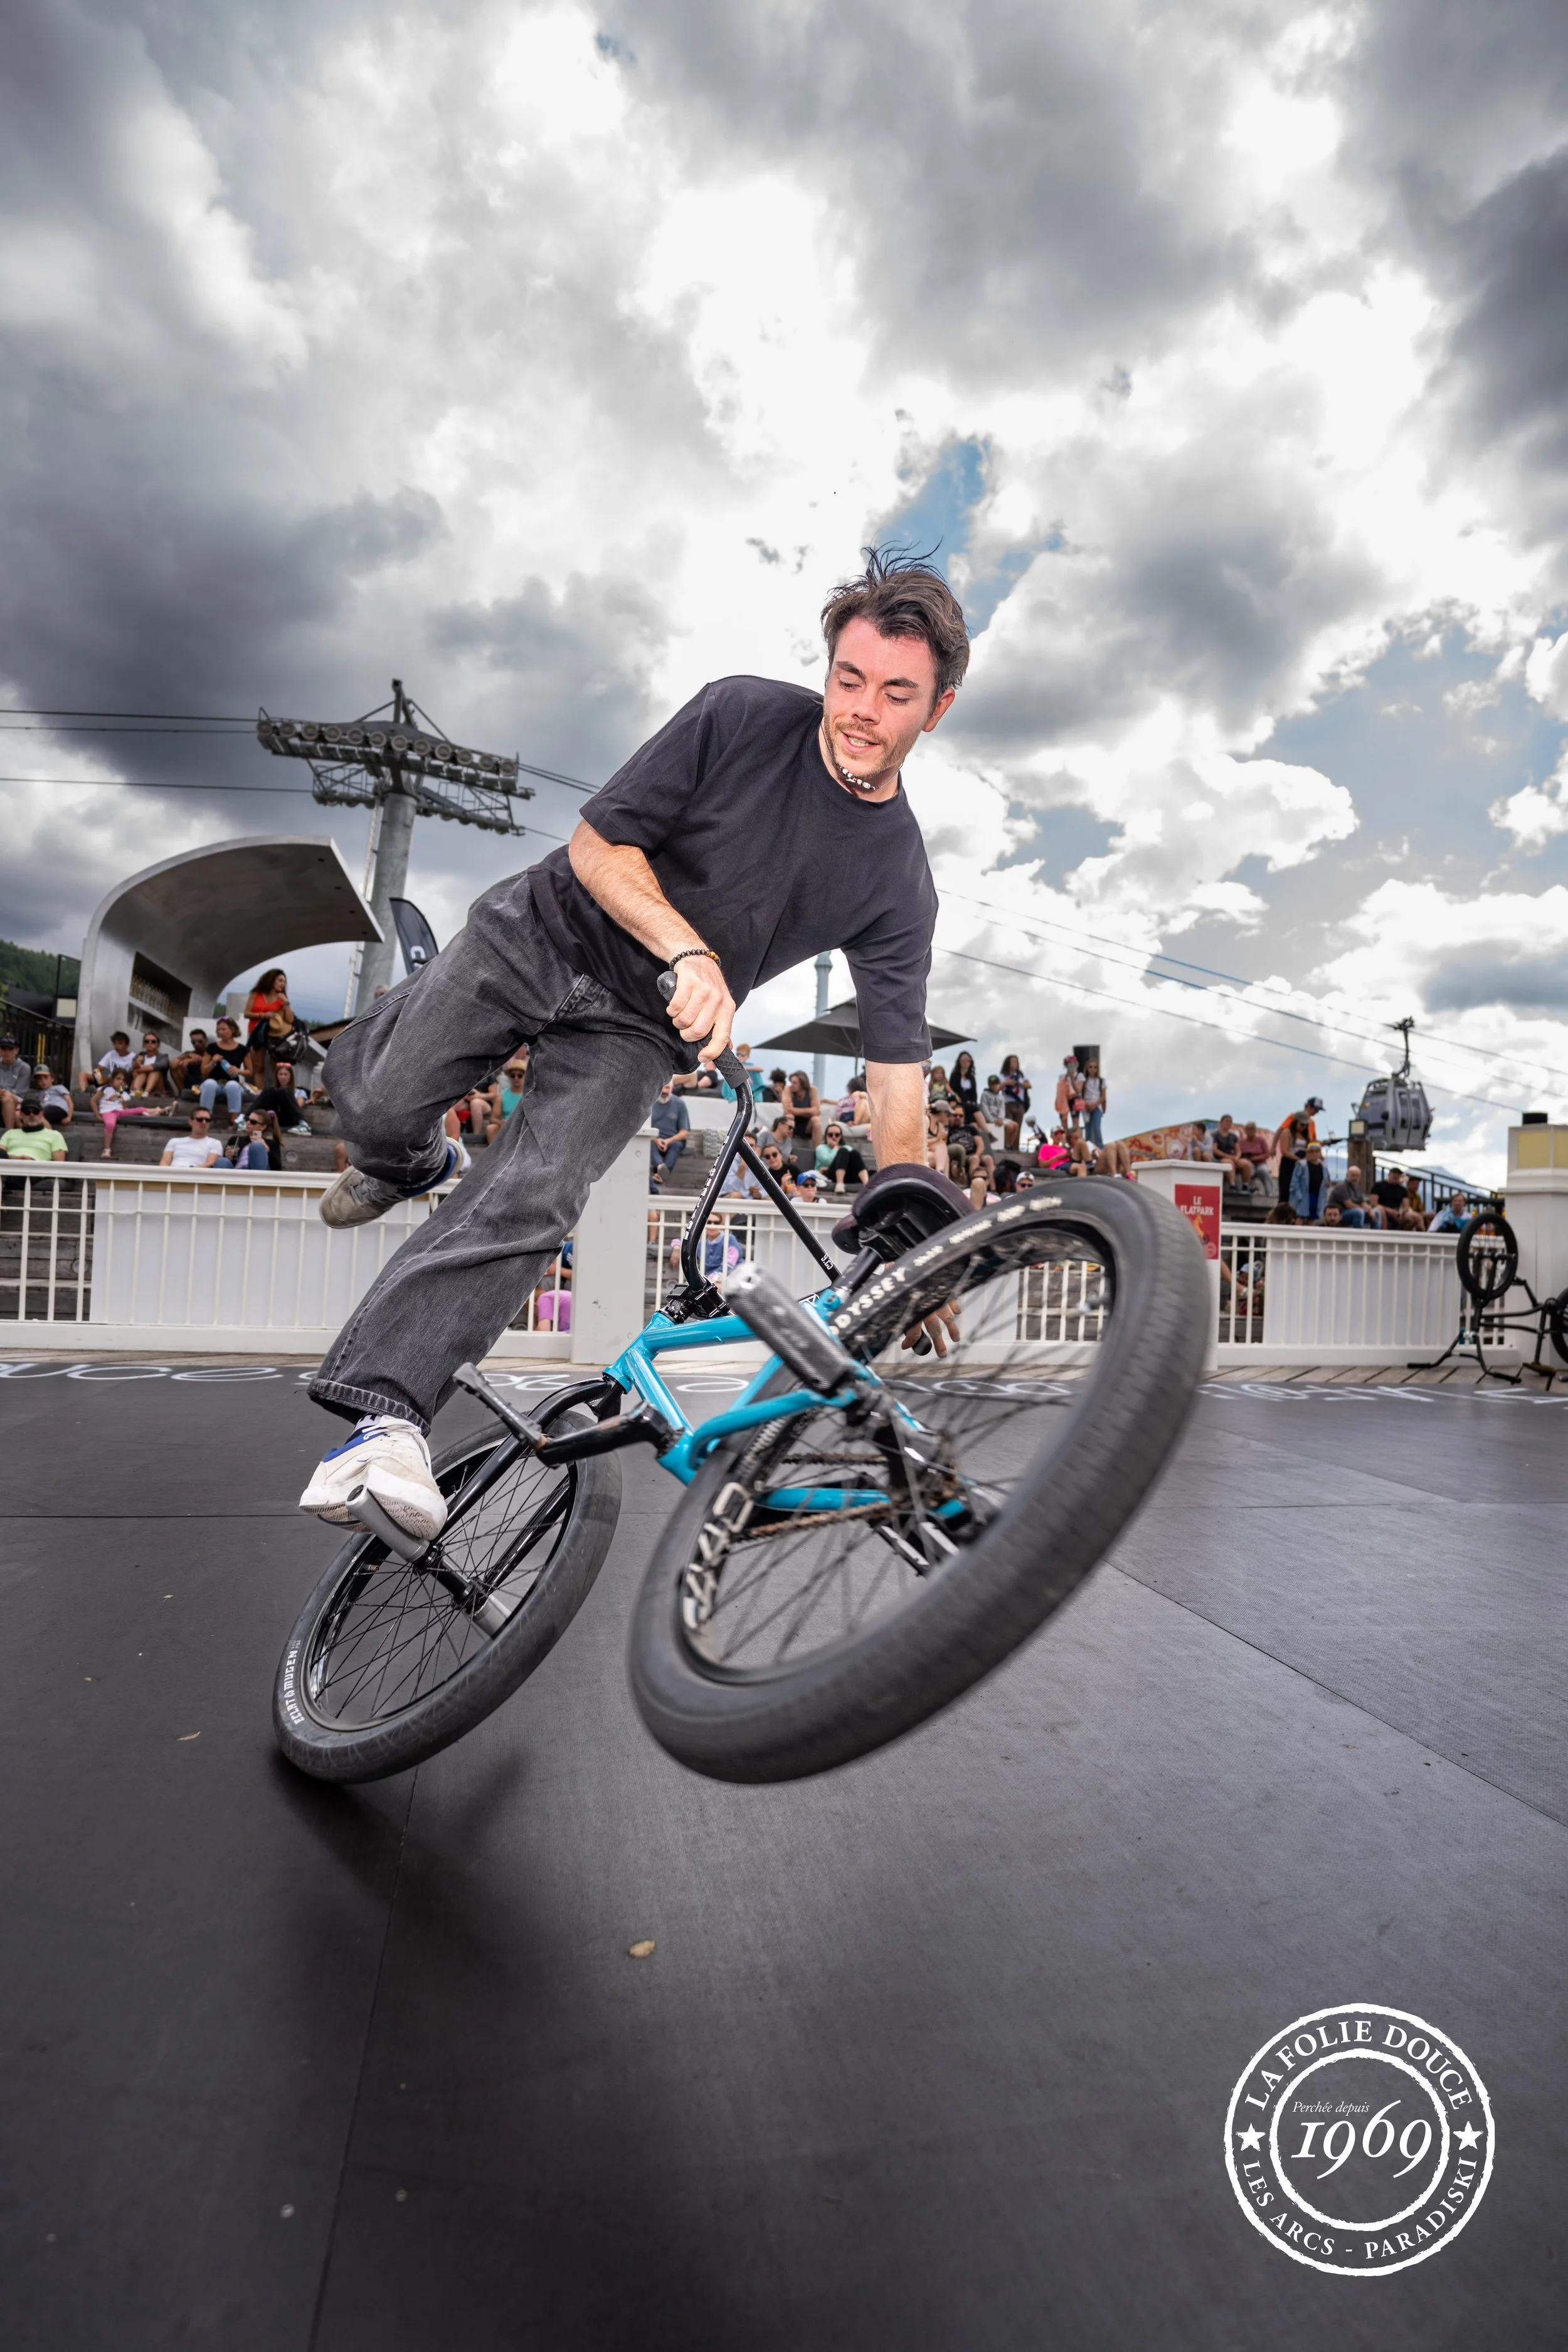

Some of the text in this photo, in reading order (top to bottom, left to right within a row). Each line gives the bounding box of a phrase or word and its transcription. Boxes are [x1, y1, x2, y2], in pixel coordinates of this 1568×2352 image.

[1193, 1195, 1202, 1205] LE
[1180, 1205, 1214, 1216] FLATPARK
[0, 1362, 283, 1381] uce
[284, 1650, 298, 1691] MUGEN
